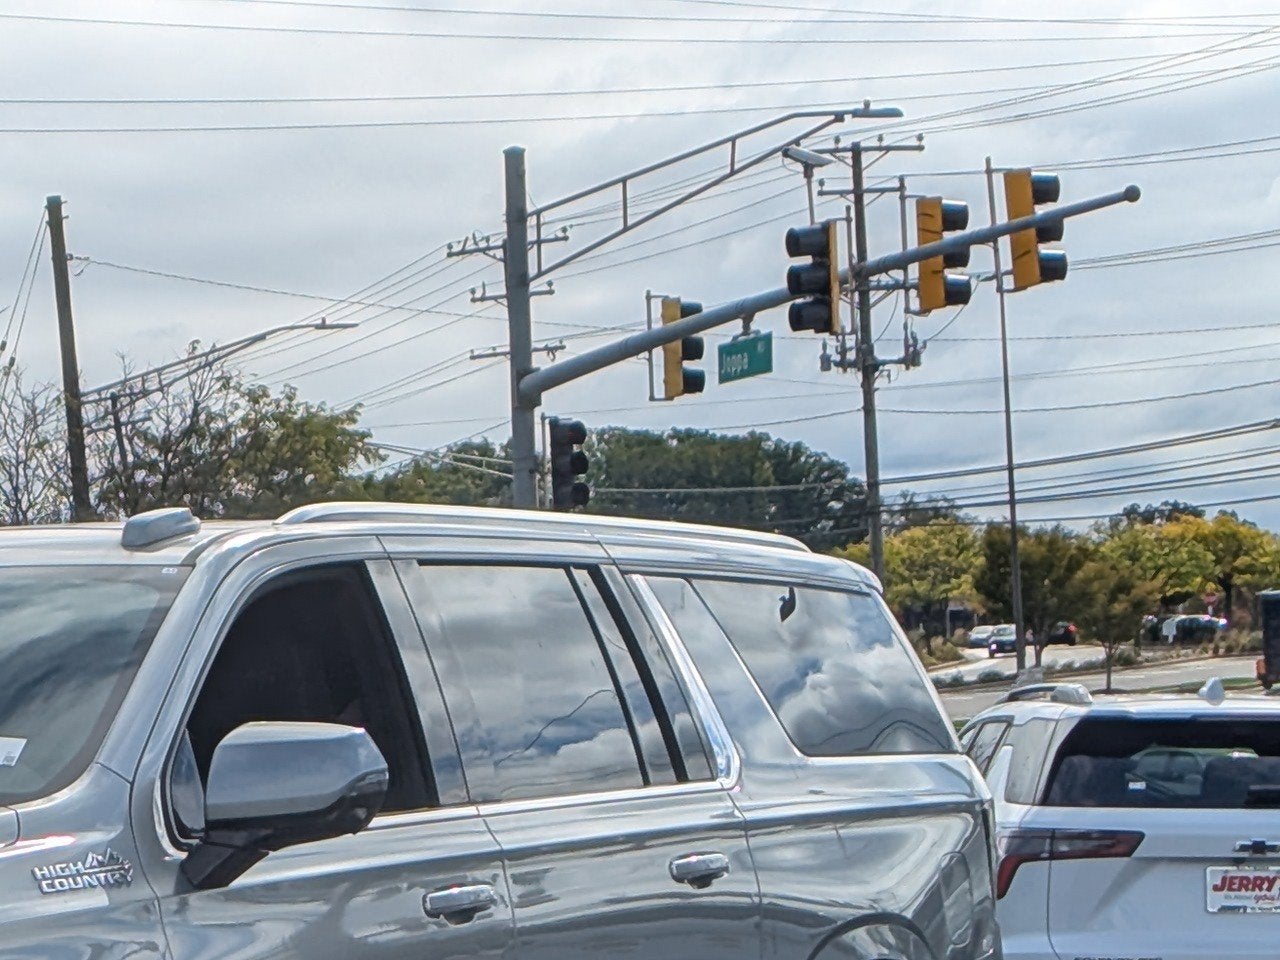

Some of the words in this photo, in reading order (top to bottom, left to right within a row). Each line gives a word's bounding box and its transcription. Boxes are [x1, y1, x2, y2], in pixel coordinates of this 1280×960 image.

[721, 351, 749, 376] Joppa
[32, 861, 86, 881] HIGH
[39, 859, 134, 894] COUNTRY
